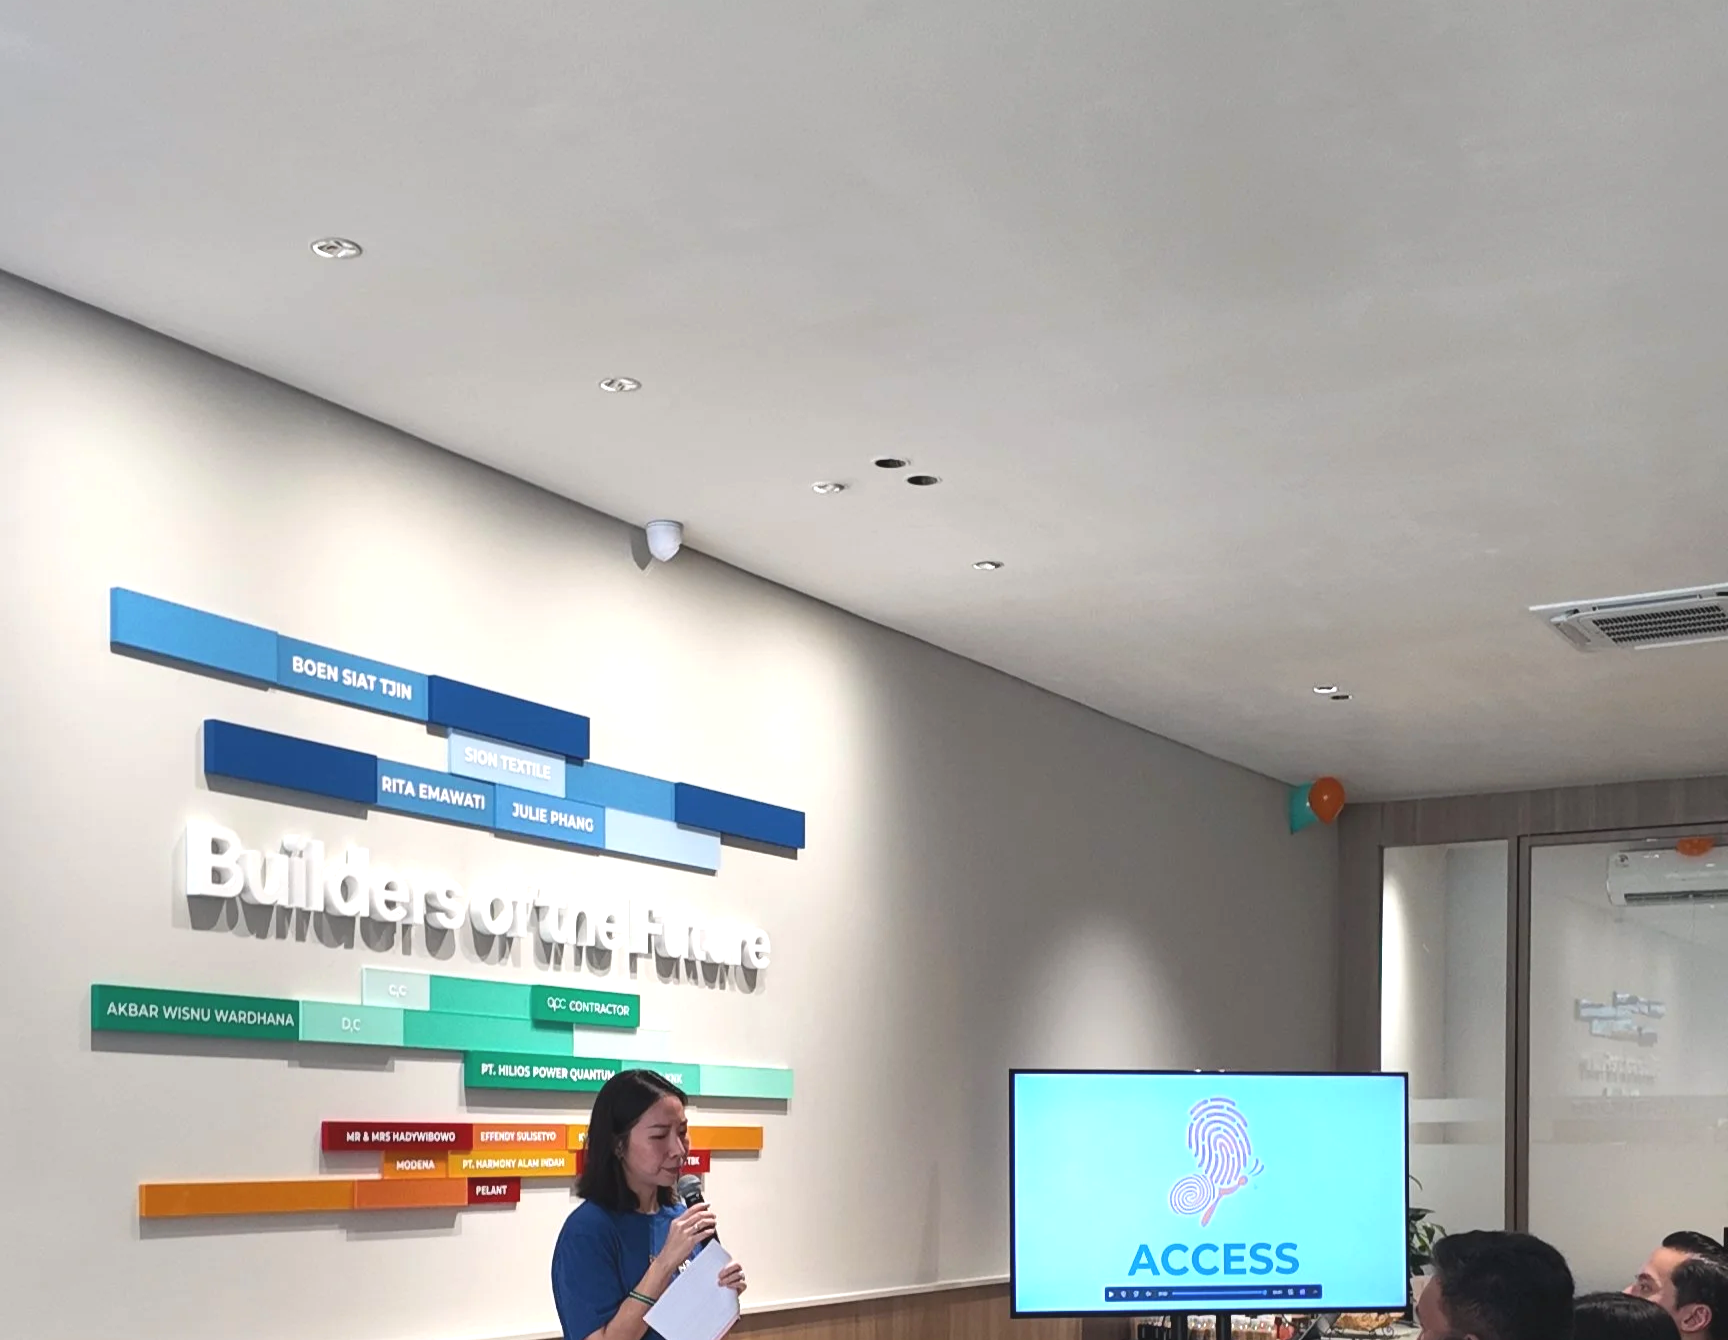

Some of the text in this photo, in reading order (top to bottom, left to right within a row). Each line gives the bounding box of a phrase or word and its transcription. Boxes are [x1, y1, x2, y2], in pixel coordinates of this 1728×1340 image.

[292, 655, 412, 701] BOEN SIAT TJIN
[464, 746, 551, 780] SION TEXTILE
[382, 775, 485, 810] RITA EMAWATI
[512, 802, 594, 833] JULIE PHANG
[185, 819, 468, 930] Builders
[533, 884, 622, 950] the
[629, 898, 771, 970] Future
[106, 1001, 295, 1027] AKBAR WISNU WARDHANA
[569, 1000, 630, 1017] CONTRACTOR
[481, 1062, 497, 1076] PT.
[498, 1064, 530, 1078] HILIOS
[533, 1066, 567, 1080] POWER
[346, 1131, 456, 1142] MR & MRS HADYWIBOWO
[480, 1131, 515, 1142] EFFENDY
[396, 1159, 435, 1170] MODENA
[462, 1157, 565, 1169] PT. HARMONY ALAM INDAH
[475, 1185, 507, 1196] PELANT
[1128, 1242, 1300, 1276] ACCESS
